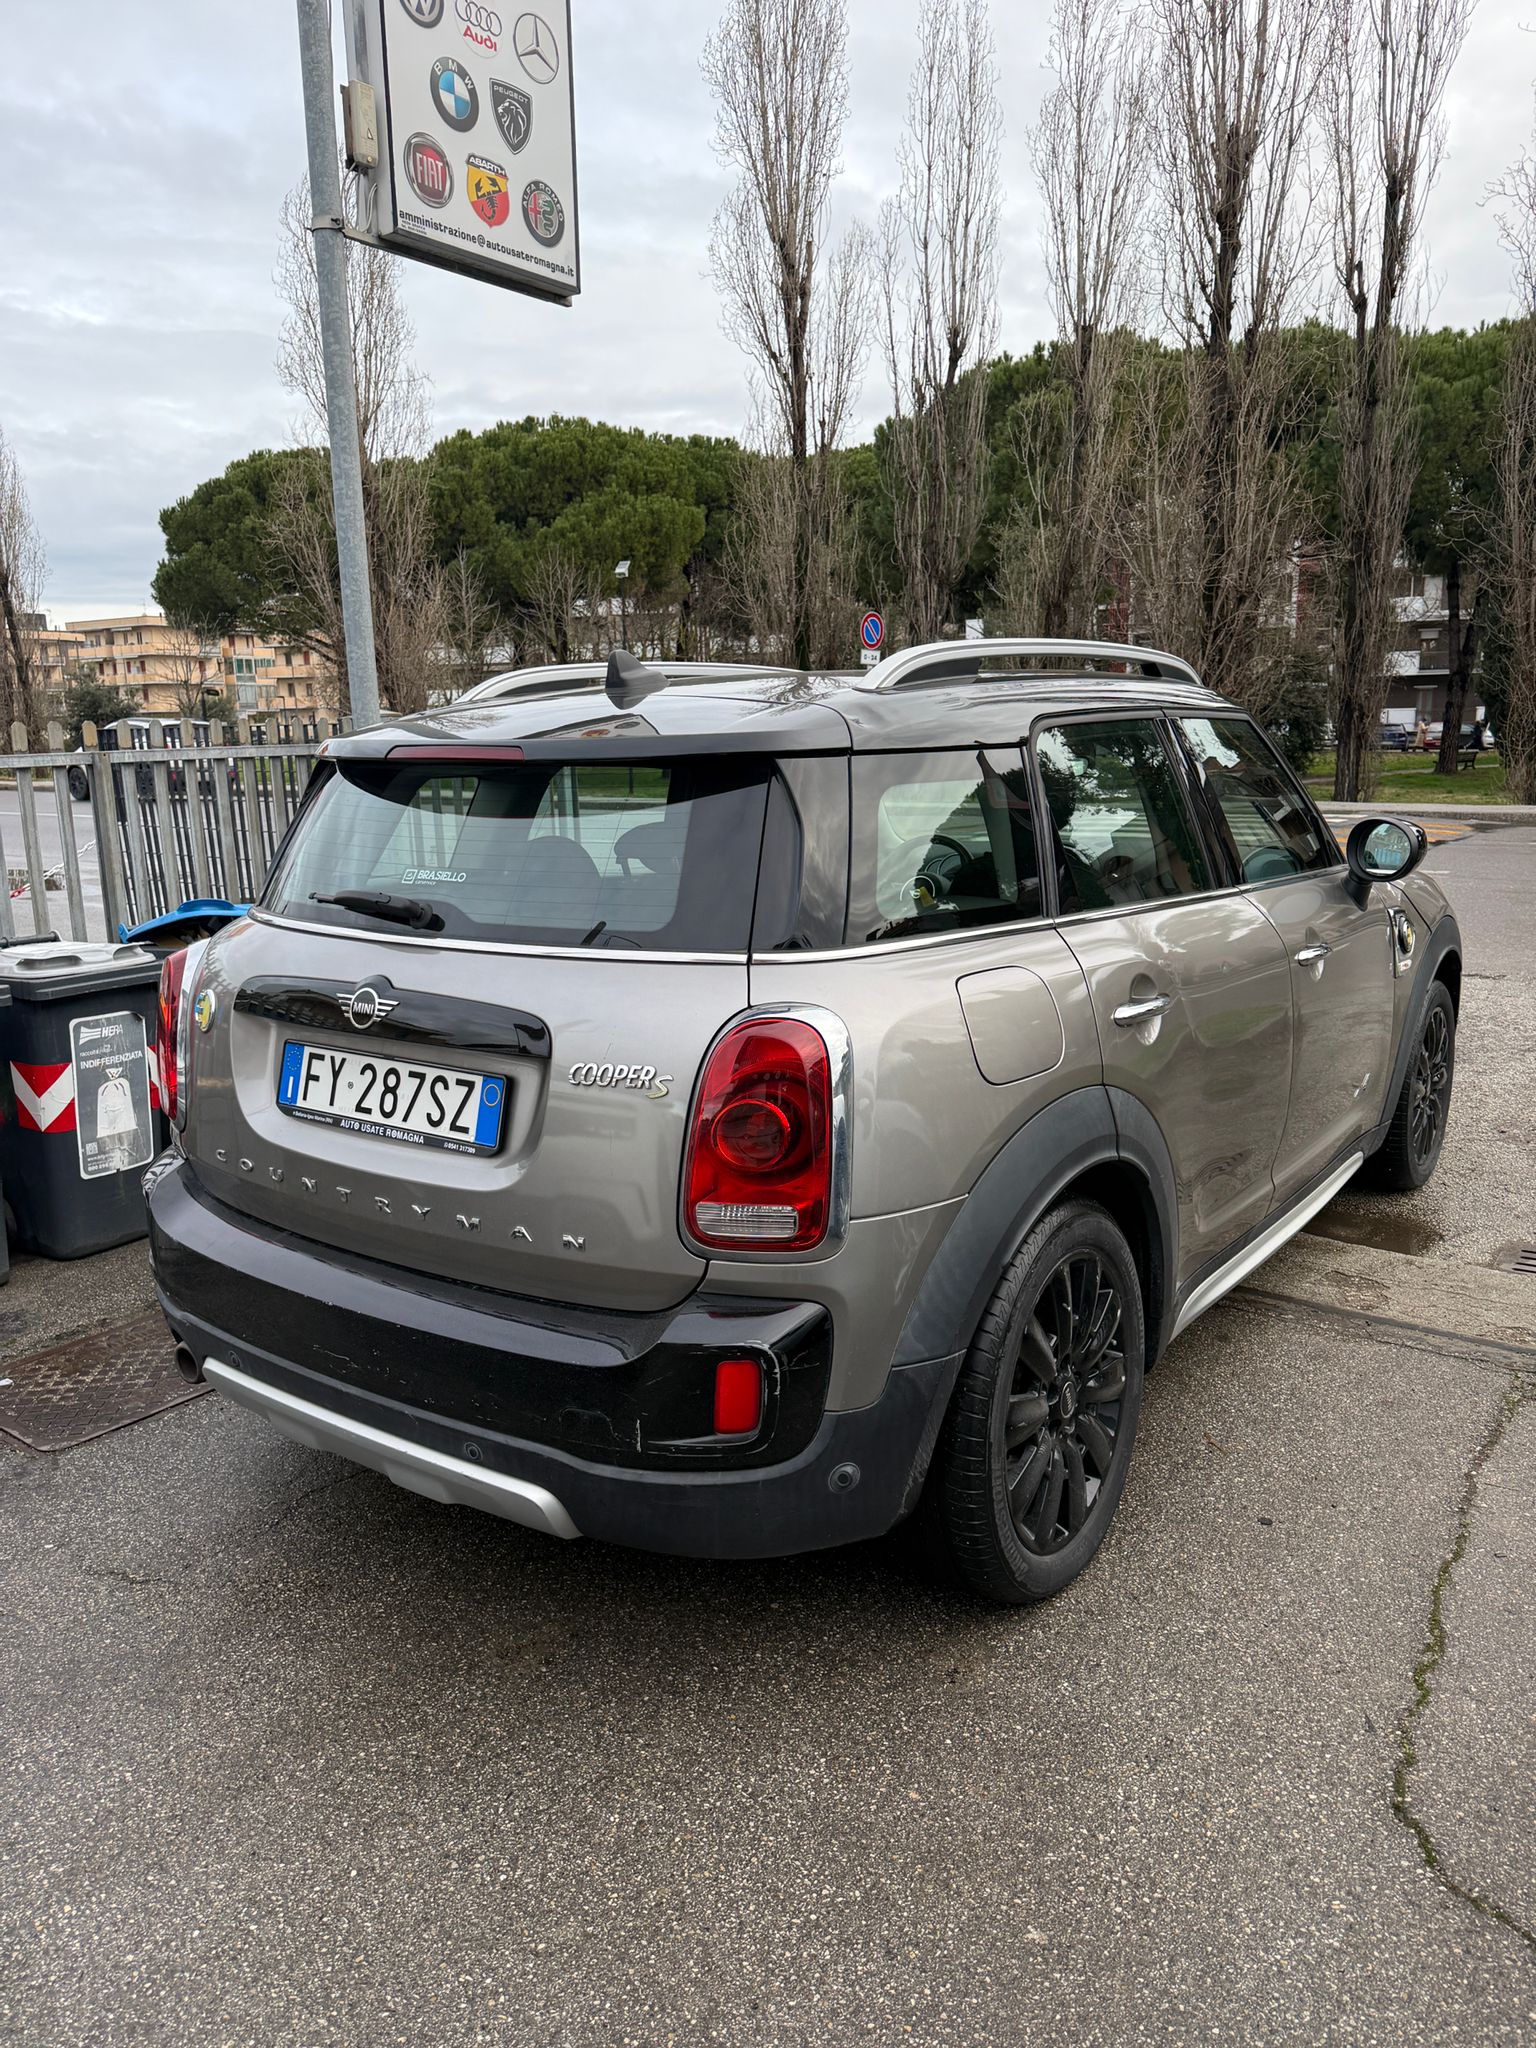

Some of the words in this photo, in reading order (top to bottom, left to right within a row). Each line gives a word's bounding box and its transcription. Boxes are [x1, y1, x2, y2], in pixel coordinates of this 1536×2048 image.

[463, 25, 498, 52] Audi
[433, 60, 475, 89] BMW
[493, 85, 529, 104] PEUGEOT
[415, 152, 444, 191] FIAT
[469, 156, 505, 176] ABARTH
[523, 183, 537, 208] ALFA
[539, 183, 564, 221] ROMEO
[399, 210, 575, 277] amministrazione@autousateromagna.it
[417, 870, 467, 882] BRASIELLO
[352, 1001, 374, 1015] MINI
[101, 1024, 124, 1038] HERA
[80, 1050, 143, 1070] INDIFFERENZIATA
[302, 1052, 347, 1107] FY
[354, 1063, 476, 1135] 287SZ
[340, 1119, 360, 1130] AUTO
[361, 1124, 384, 1136] USATE
[385, 1129, 425, 1144] ROMAGNA
[215, 1148, 586, 1251] COUNTRYMAN
